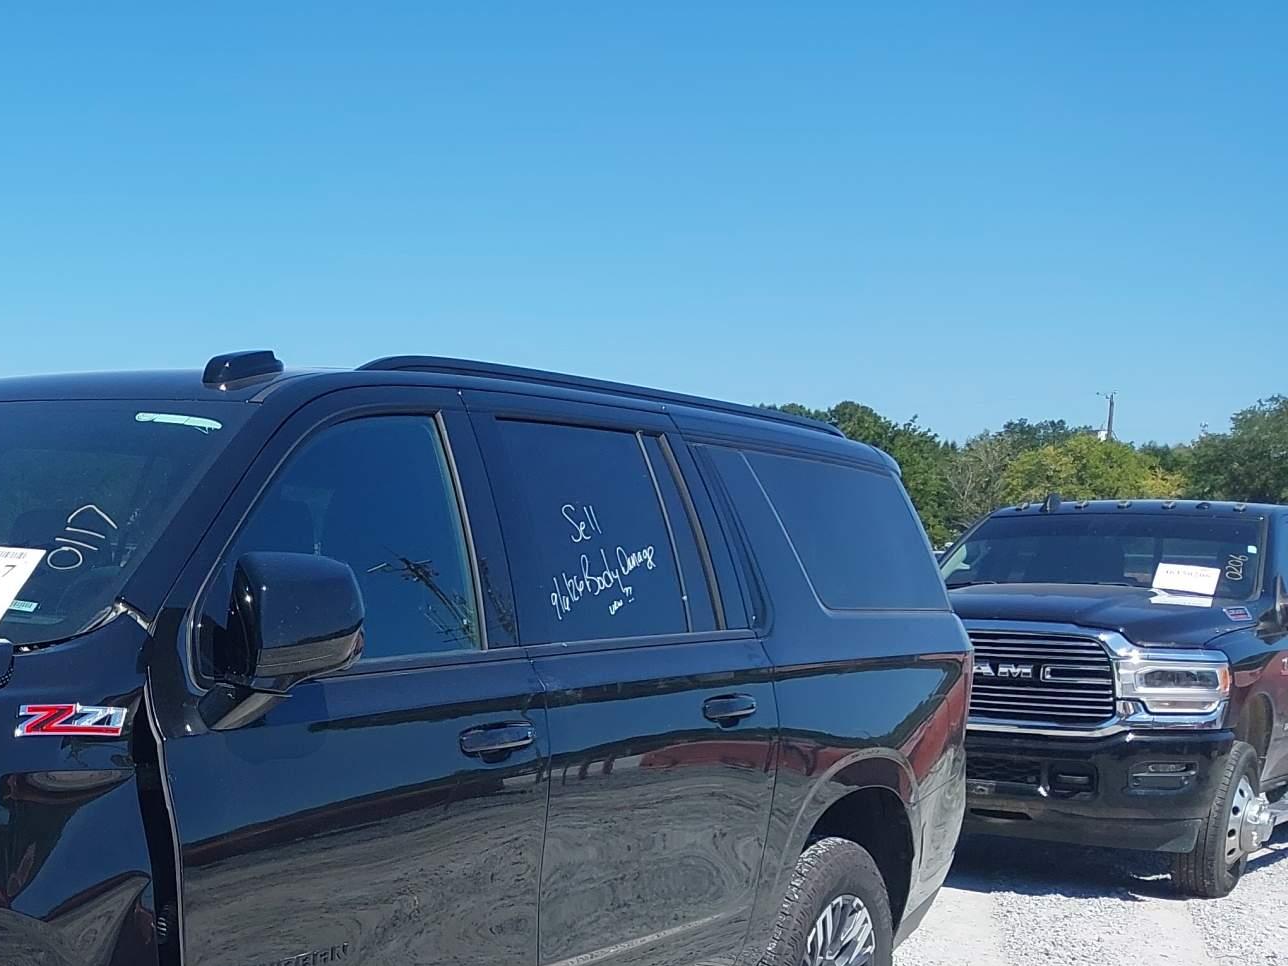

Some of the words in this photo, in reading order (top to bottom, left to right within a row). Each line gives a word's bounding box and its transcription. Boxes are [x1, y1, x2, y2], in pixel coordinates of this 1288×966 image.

[48, 505, 118, 569] 0117
[561, 504, 602, 542] Sell
[580, 548, 626, 595] Body
[1225, 554, 1249, 581] 0206
[973, 662, 1033, 678] AM
[15, 702, 128, 737] Z71
